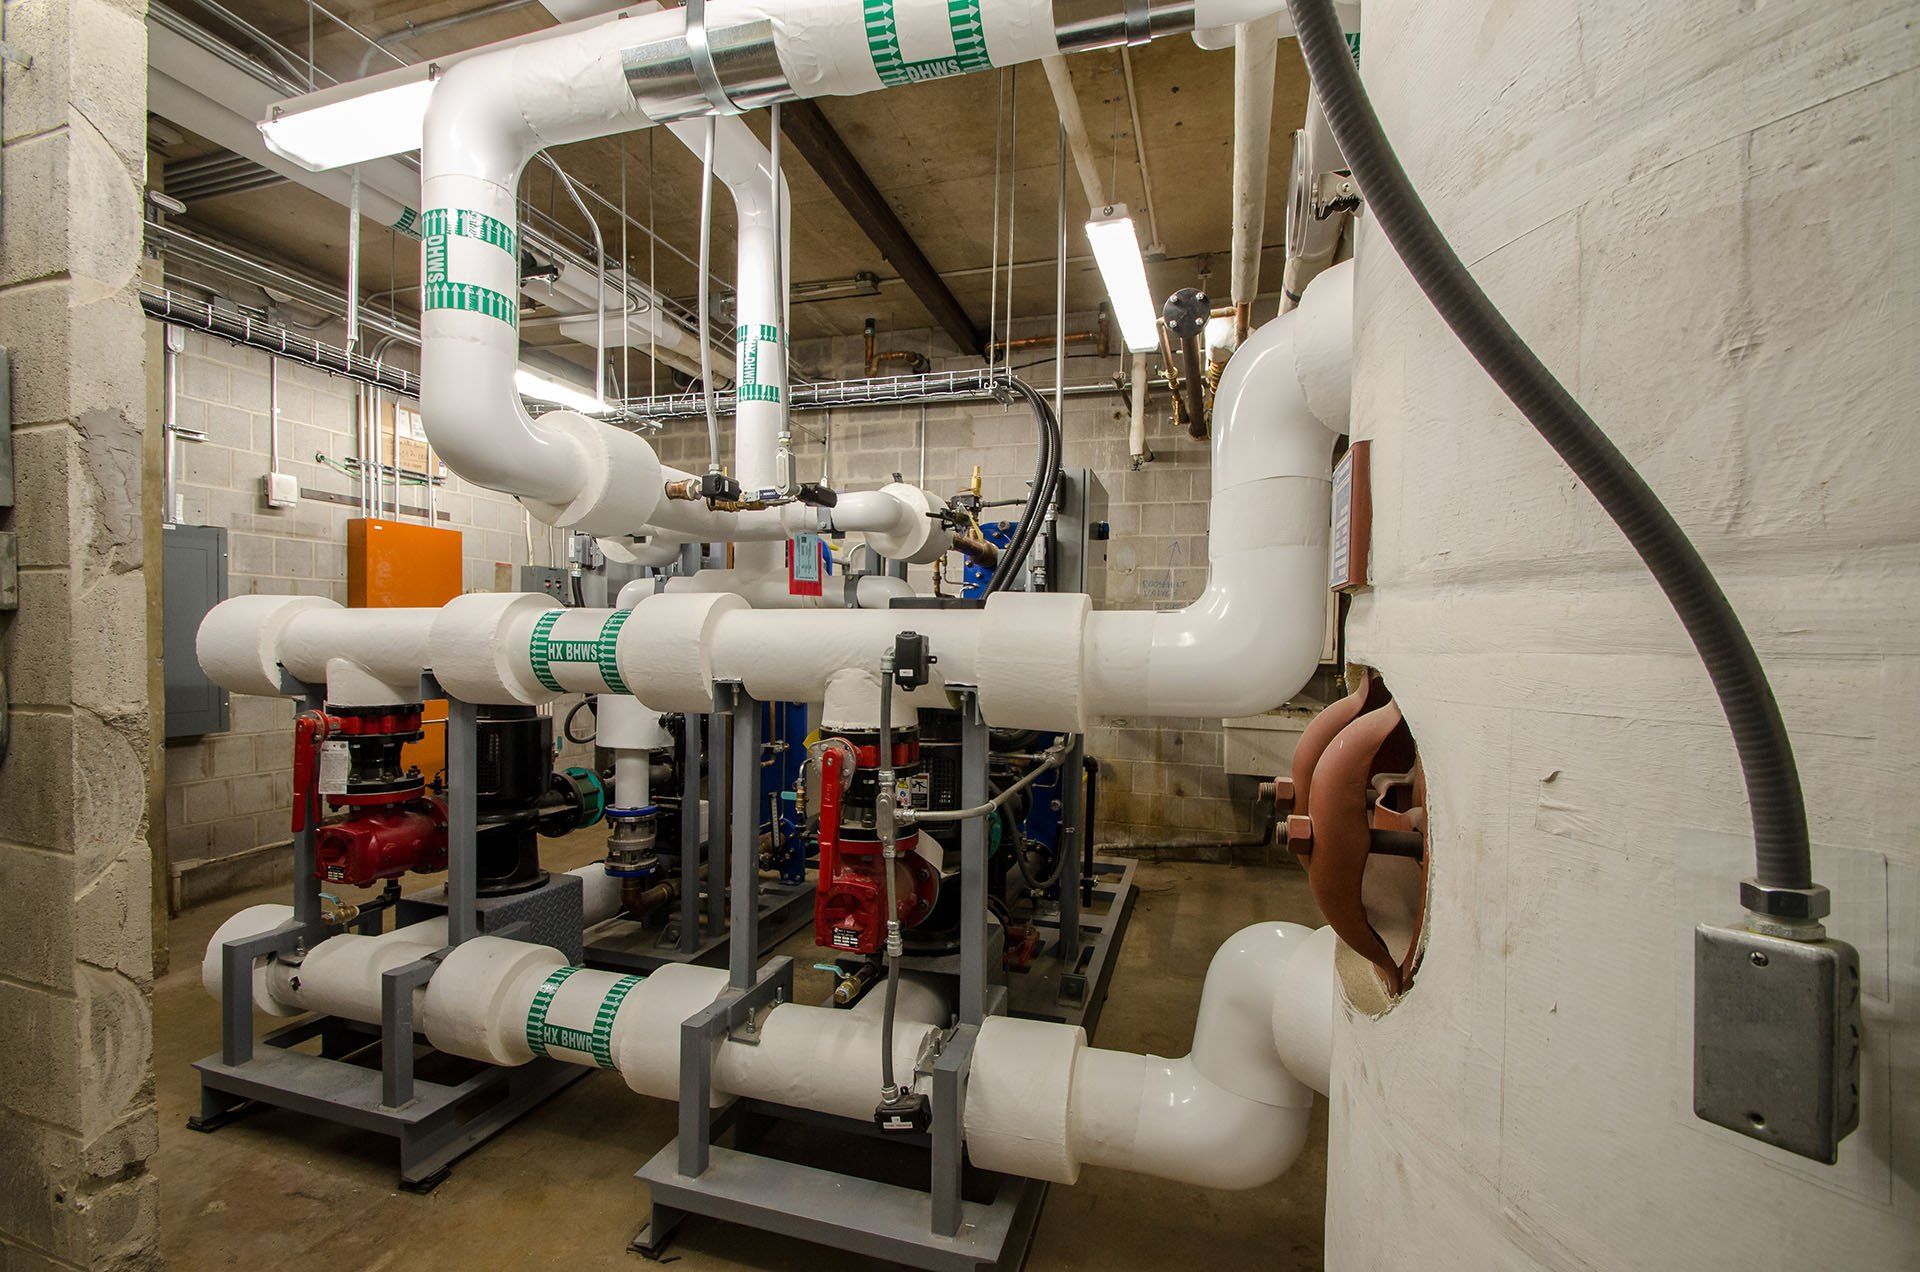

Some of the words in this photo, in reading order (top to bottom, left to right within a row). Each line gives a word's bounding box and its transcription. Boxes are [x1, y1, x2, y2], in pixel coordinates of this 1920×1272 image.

[905, 59, 961, 81] DHWS
[427, 234, 445, 283] DHWS
[743, 356, 756, 386] DHWR
[547, 642, 564, 660] HX
[566, 643, 598, 661] BHWS
[543, 1026, 559, 1045] HX
[561, 1030, 593, 1052] BHWR
